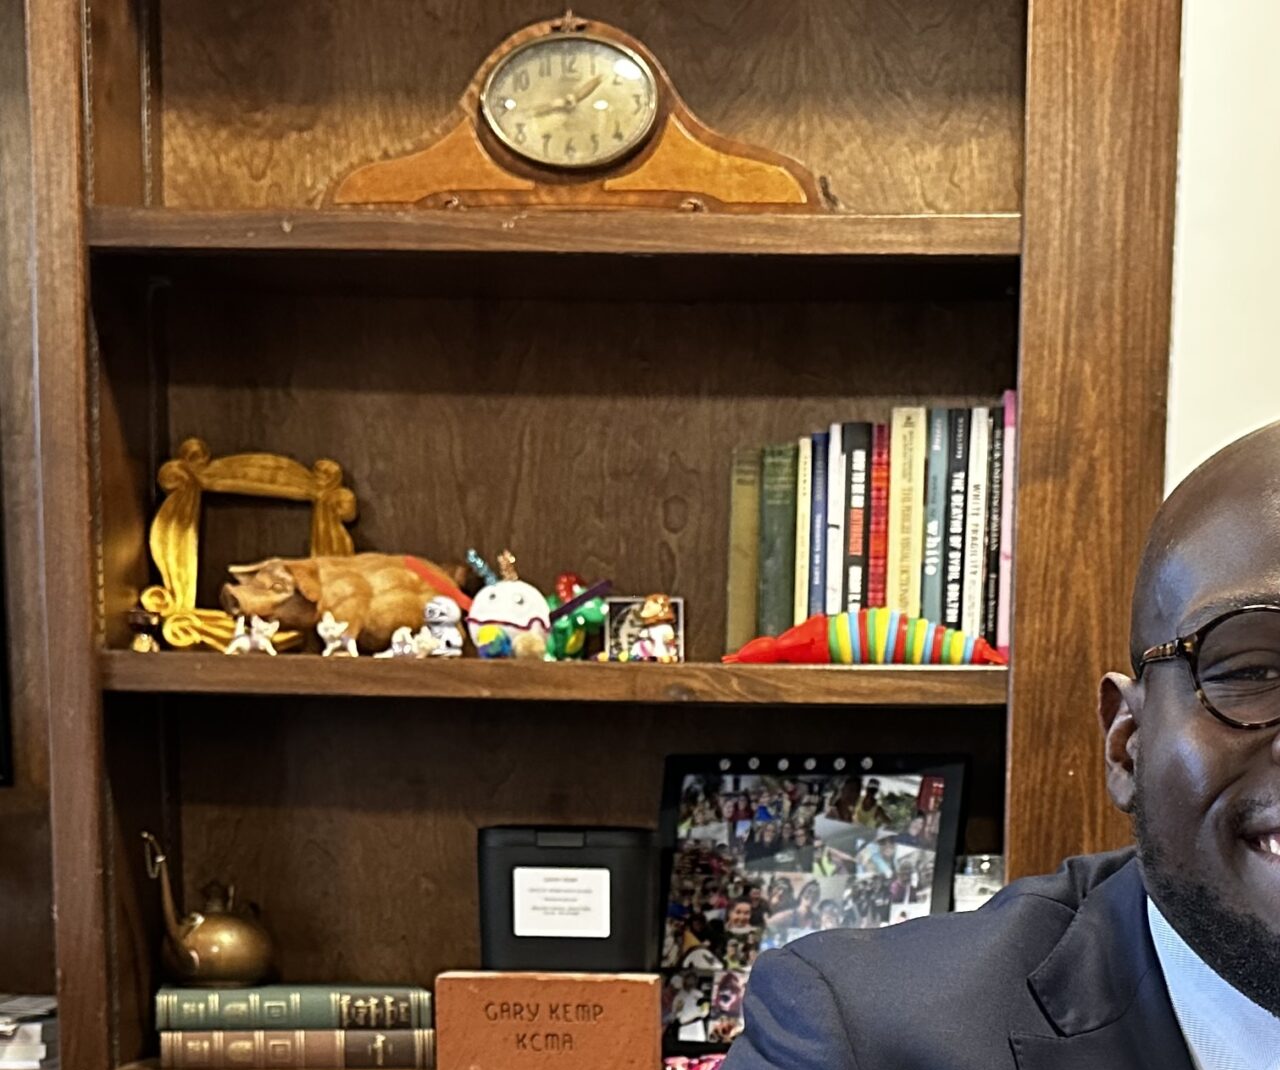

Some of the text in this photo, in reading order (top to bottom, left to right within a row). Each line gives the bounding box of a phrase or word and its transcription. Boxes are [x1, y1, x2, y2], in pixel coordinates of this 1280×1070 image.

[951, 471, 965, 493] THE
[949, 493, 964, 534] DEATHS
[971, 483, 982, 517] WHITE
[968, 522, 981, 576] FRAGILITY
[484, 1002, 604, 1023] GARY KEMP
[516, 1033, 574, 1051] KCMA
